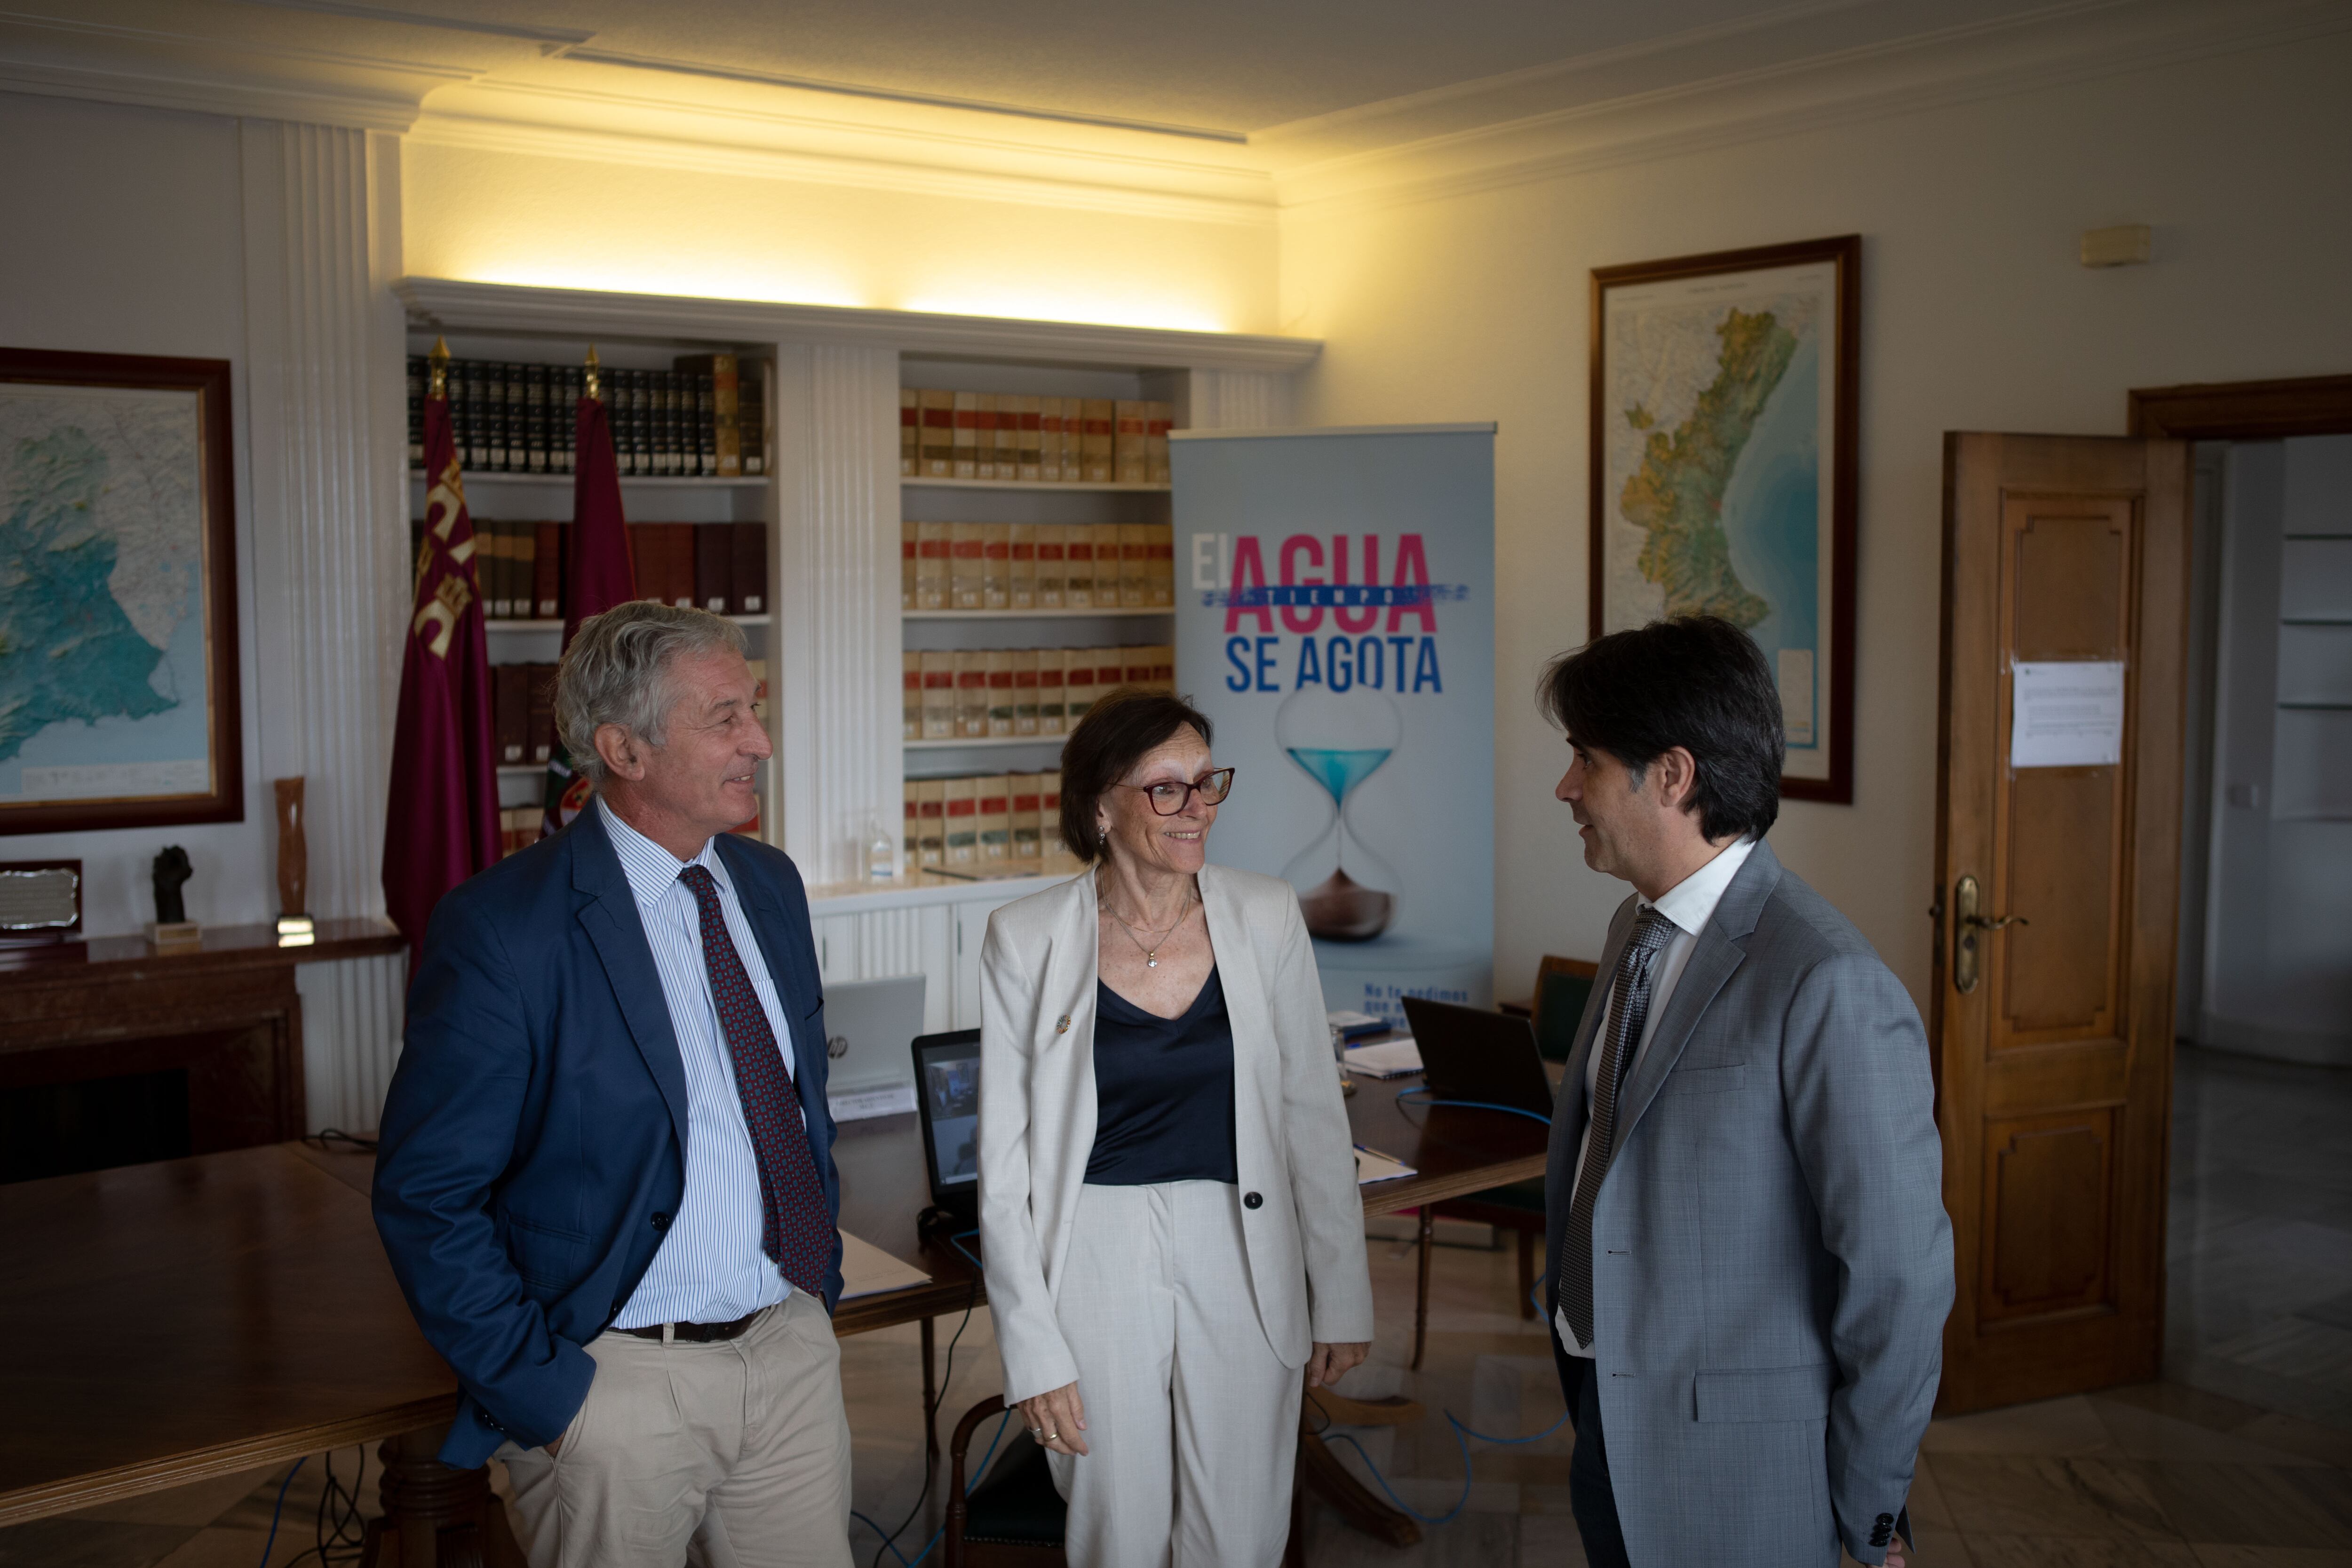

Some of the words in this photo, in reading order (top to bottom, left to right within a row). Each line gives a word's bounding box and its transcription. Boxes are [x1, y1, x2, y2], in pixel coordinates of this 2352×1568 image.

[1224, 533, 1438, 634] AGUA
[1268, 589, 1394, 605] TIEMPO
[1226, 636, 1280, 693] SE
[1295, 636, 1443, 693] AGOTA
[1365, 982, 1382, 998] No
[1388, 985, 1402, 998] te
[1406, 986, 1468, 1002] pedimos
[1364, 1000, 1389, 1014] que
[827, 1036, 848, 1059] hp
